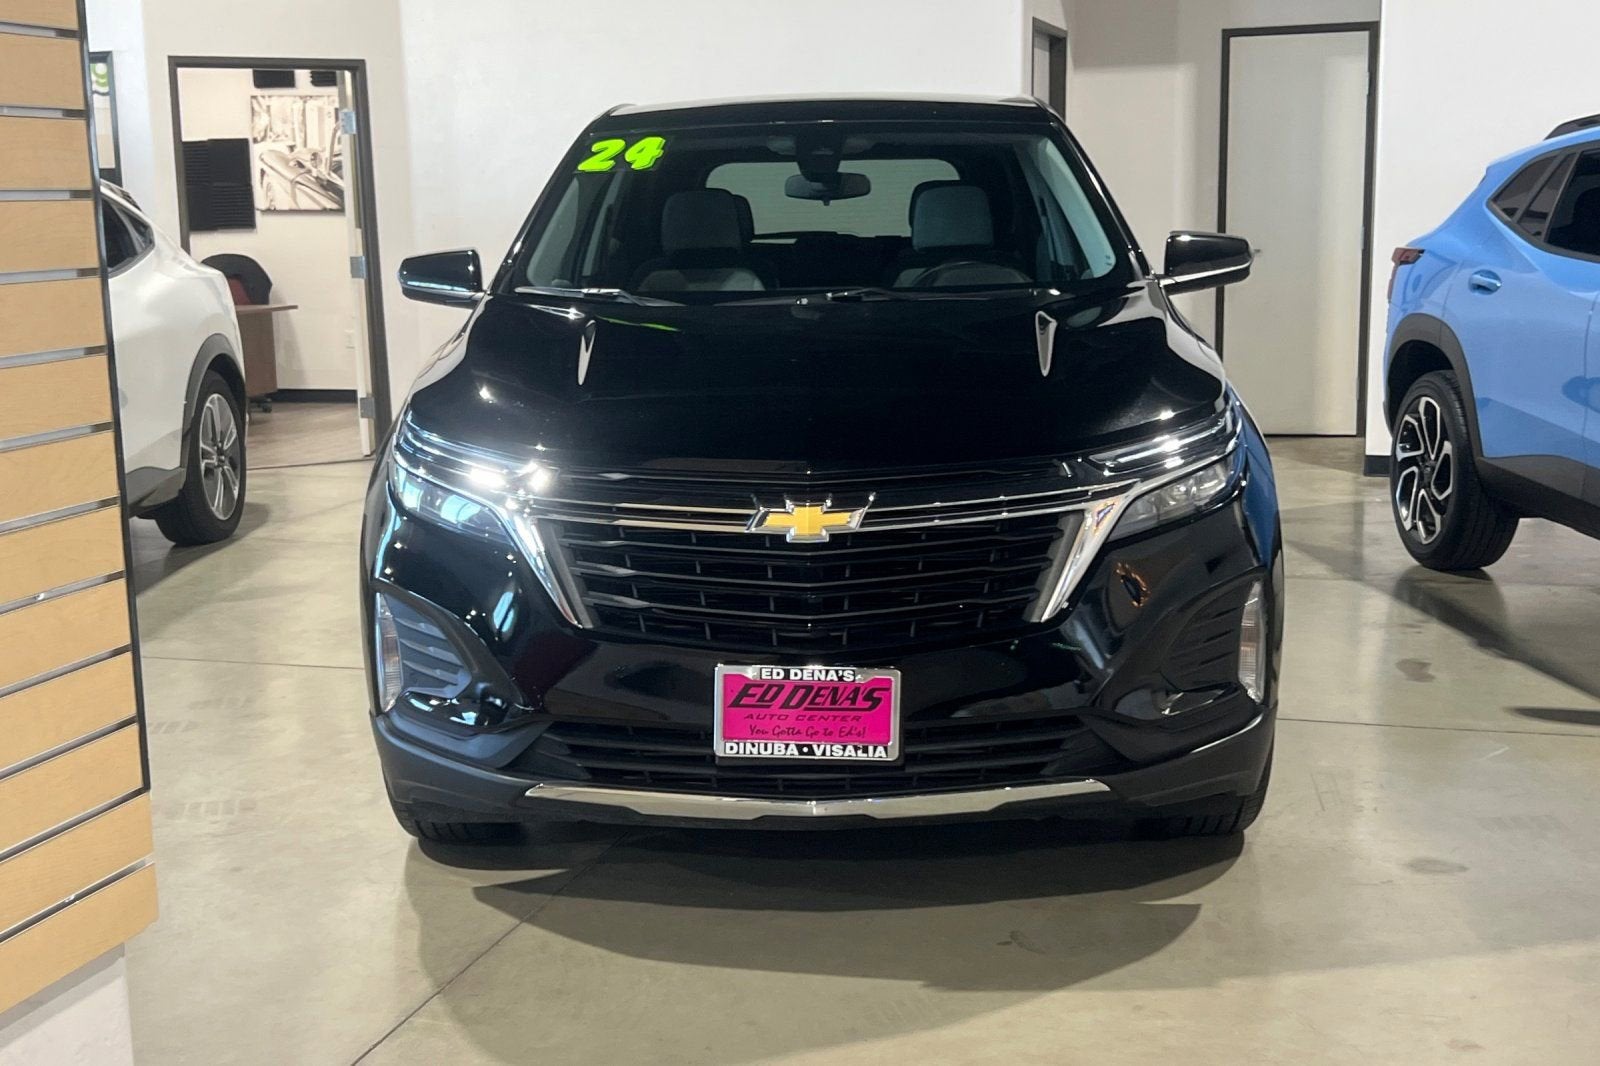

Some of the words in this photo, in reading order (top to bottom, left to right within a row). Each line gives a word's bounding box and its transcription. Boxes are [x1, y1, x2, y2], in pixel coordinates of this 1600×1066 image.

[577, 136, 666, 171] 24
[761, 668, 785, 680] ED
[790, 669, 855, 681] DENA'S
[728, 683, 785, 709] ED
[779, 684, 890, 712] DENA'S
[744, 713, 789, 721] AUTO
[796, 714, 862, 722] CENTER
[750, 724, 770, 737] You
[772, 725, 801, 738] Gotta
[806, 726, 819, 738] Go
[823, 727, 834, 737] to
[726, 742, 799, 755] DINUBA
[811, 744, 887, 758] VISALIA
